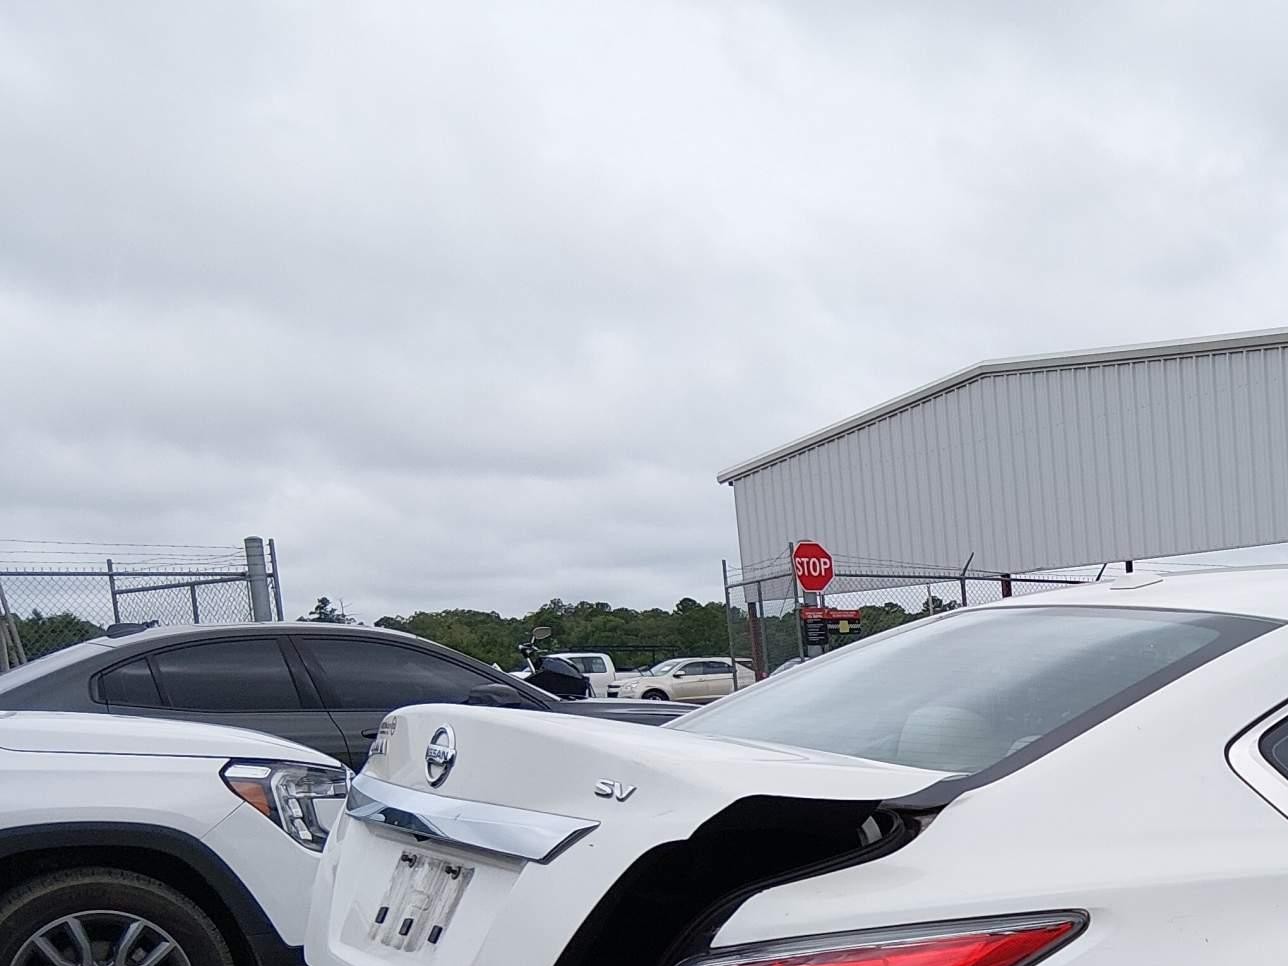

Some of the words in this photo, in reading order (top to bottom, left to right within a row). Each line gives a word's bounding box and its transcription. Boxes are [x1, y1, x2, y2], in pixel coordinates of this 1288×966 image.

[795, 557, 831, 577] STOP
[426, 747, 449, 761] SSAN
[593, 778, 637, 802] SV
